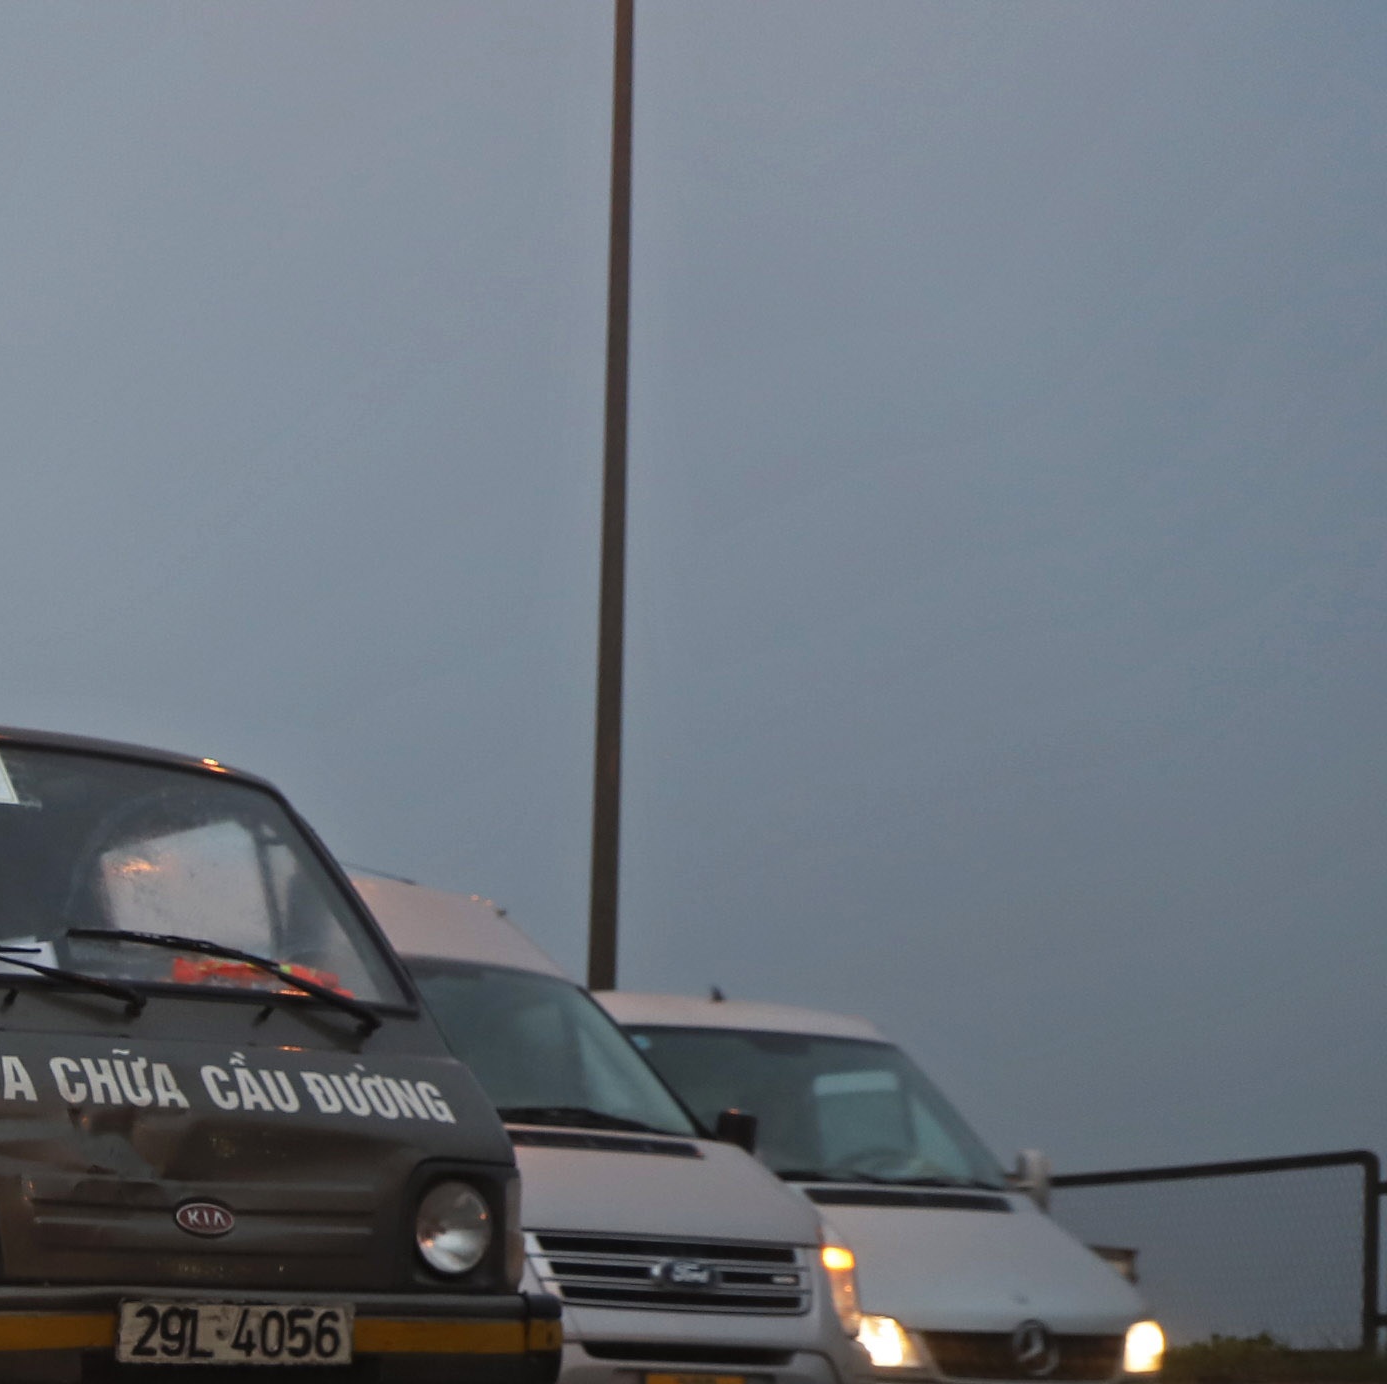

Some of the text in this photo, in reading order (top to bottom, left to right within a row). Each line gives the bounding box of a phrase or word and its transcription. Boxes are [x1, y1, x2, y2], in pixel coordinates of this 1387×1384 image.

[49, 1048, 190, 1108] CHỮA
[200, 1051, 300, 1113] CẦU
[299, 1063, 457, 1124] ĐƯỜNG
[186, 1210, 227, 1227] KIA
